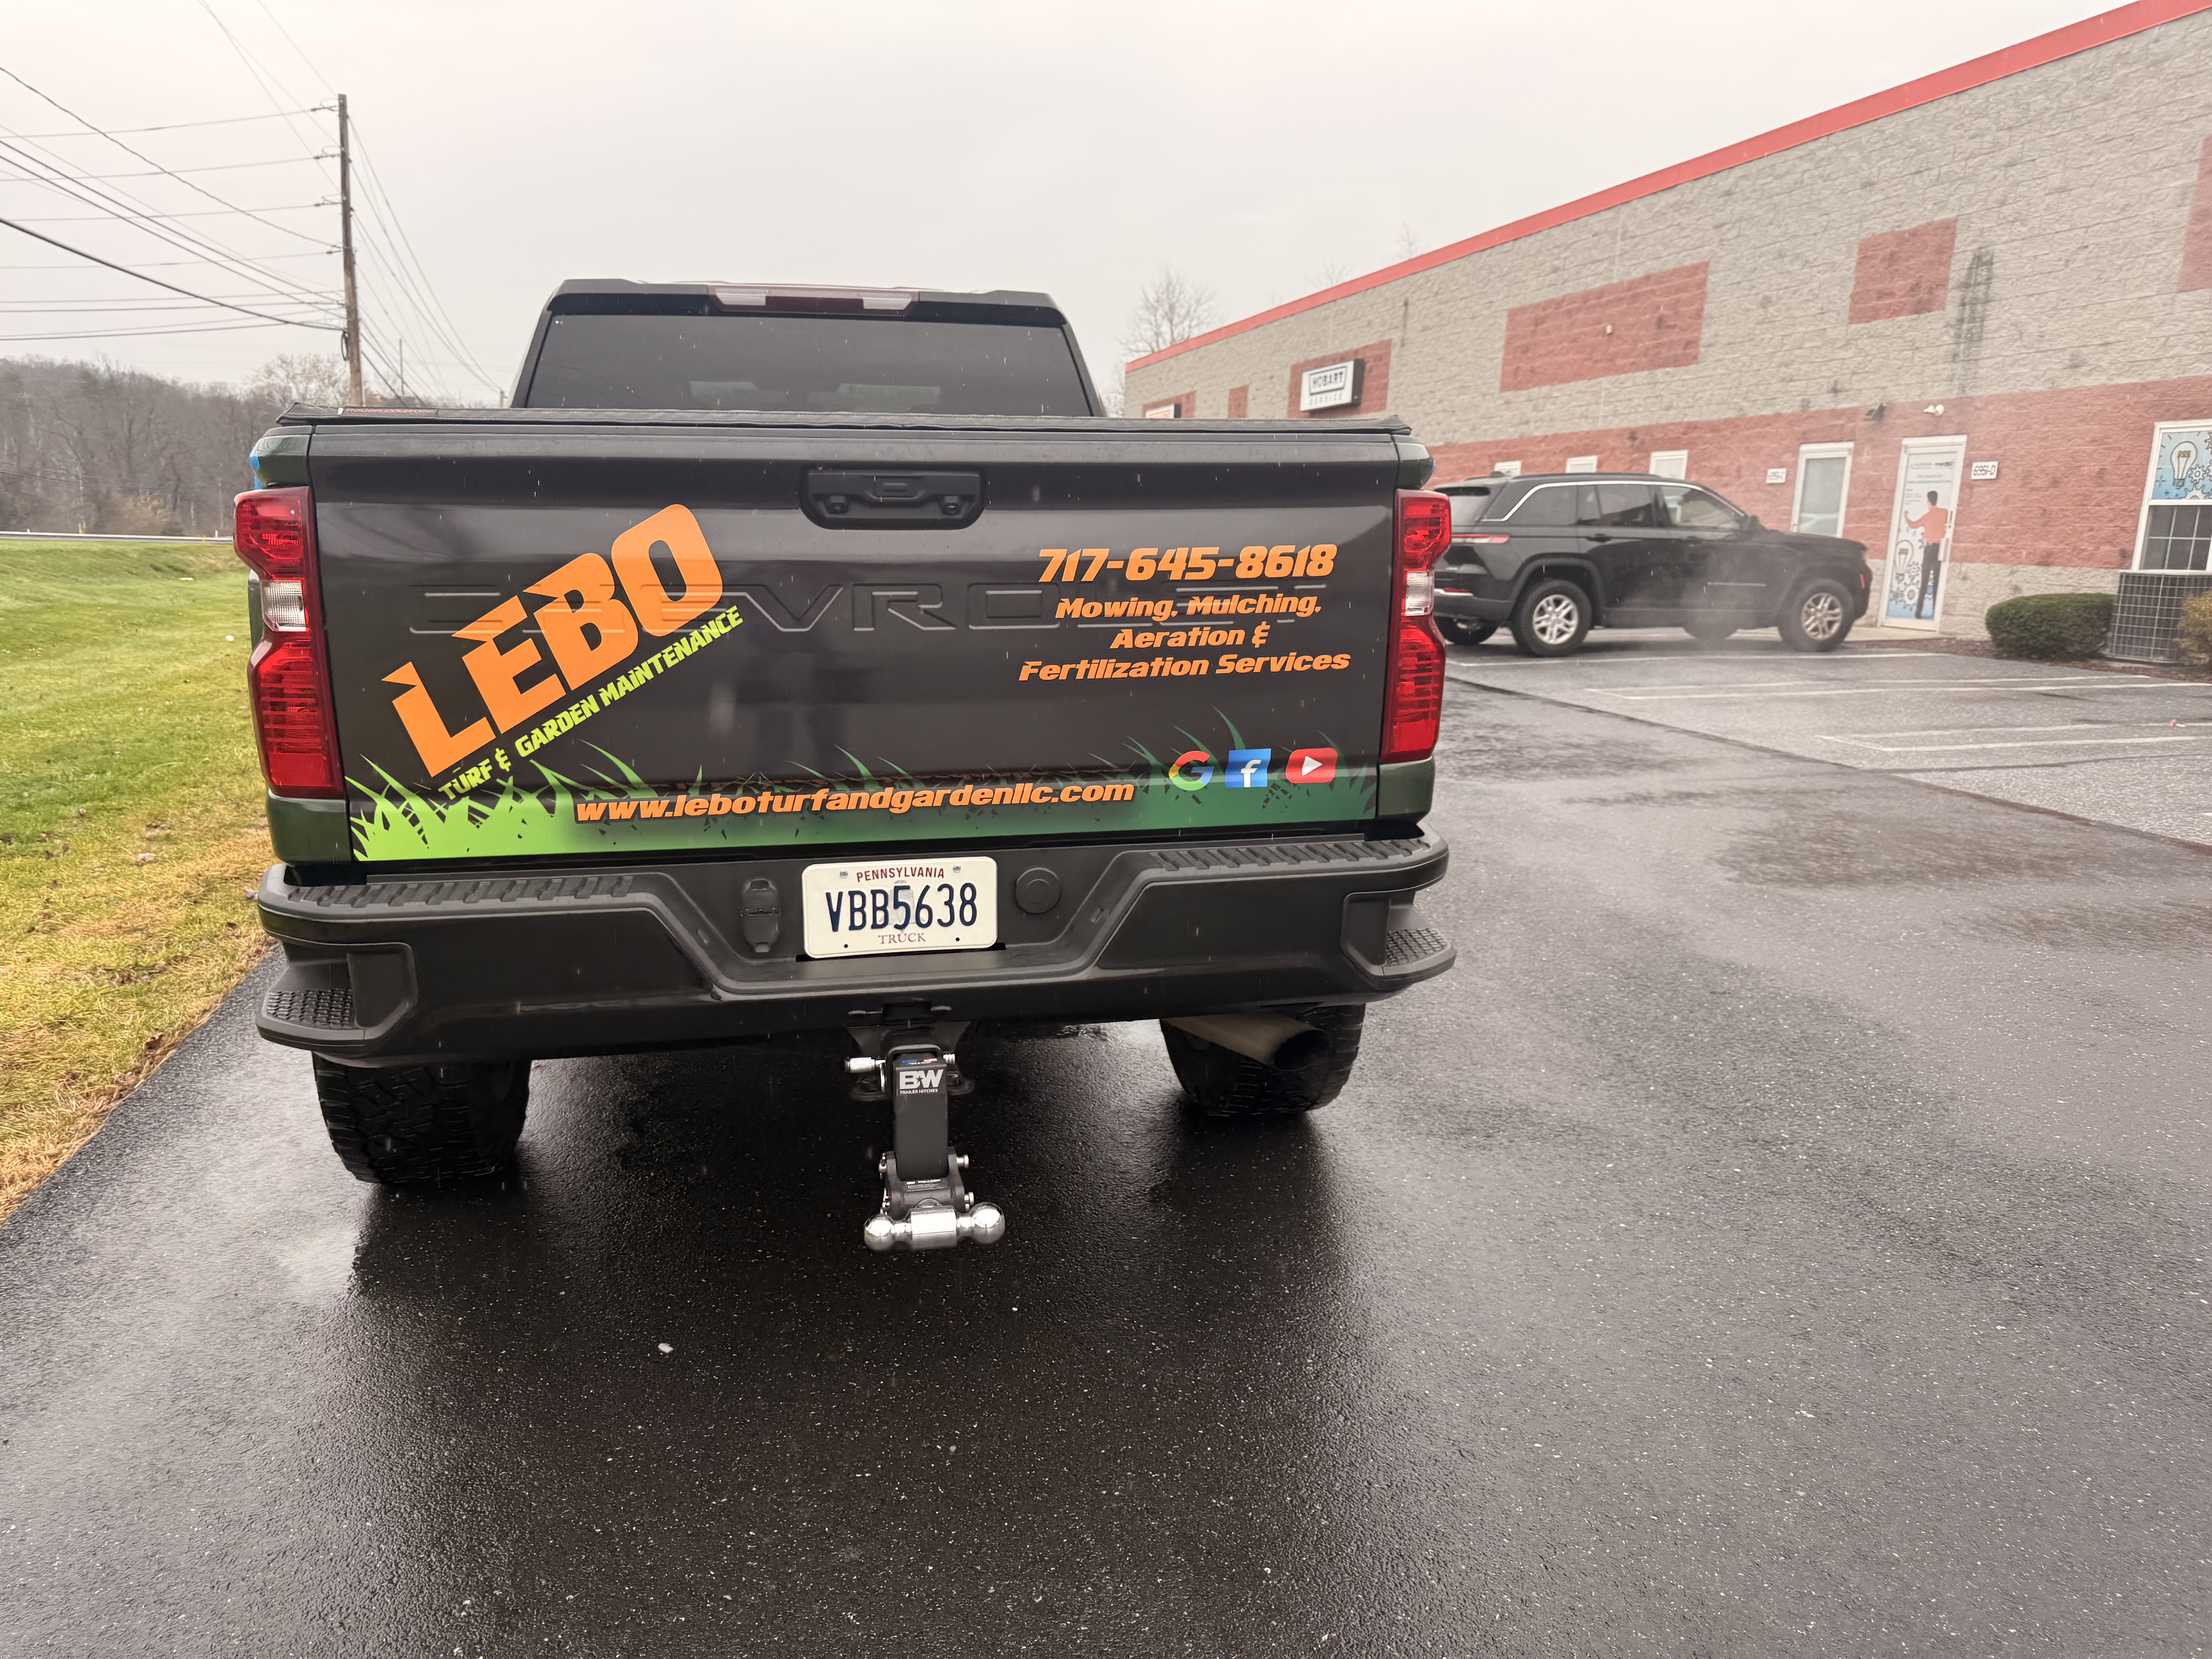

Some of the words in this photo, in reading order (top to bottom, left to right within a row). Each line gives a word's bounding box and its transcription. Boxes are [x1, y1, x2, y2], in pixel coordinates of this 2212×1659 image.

[1312, 371, 1343, 388] HOBART
[1039, 544, 1338, 583] 717-645-8618
[1055, 597, 1179, 622] Mowing,
[1186, 593, 1322, 618] Mulching,
[382, 504, 723, 778] LEBO
[1110, 626, 1246, 649] Aeration
[1251, 620, 1271, 649] &
[1018, 656, 1210, 682] Fertilization
[1215, 651, 1352, 675] Services
[438, 758, 493, 800] TURF
[495, 747, 512, 772] &
[515, 695, 600, 757] GARDEN
[576, 783, 1135, 822] www.leboturfandgardenllc.com
[856, 866, 945, 883] PENNSYLVANIA
[825, 882, 978, 932] VBB5638
[878, 933, 926, 944] TRUCK
